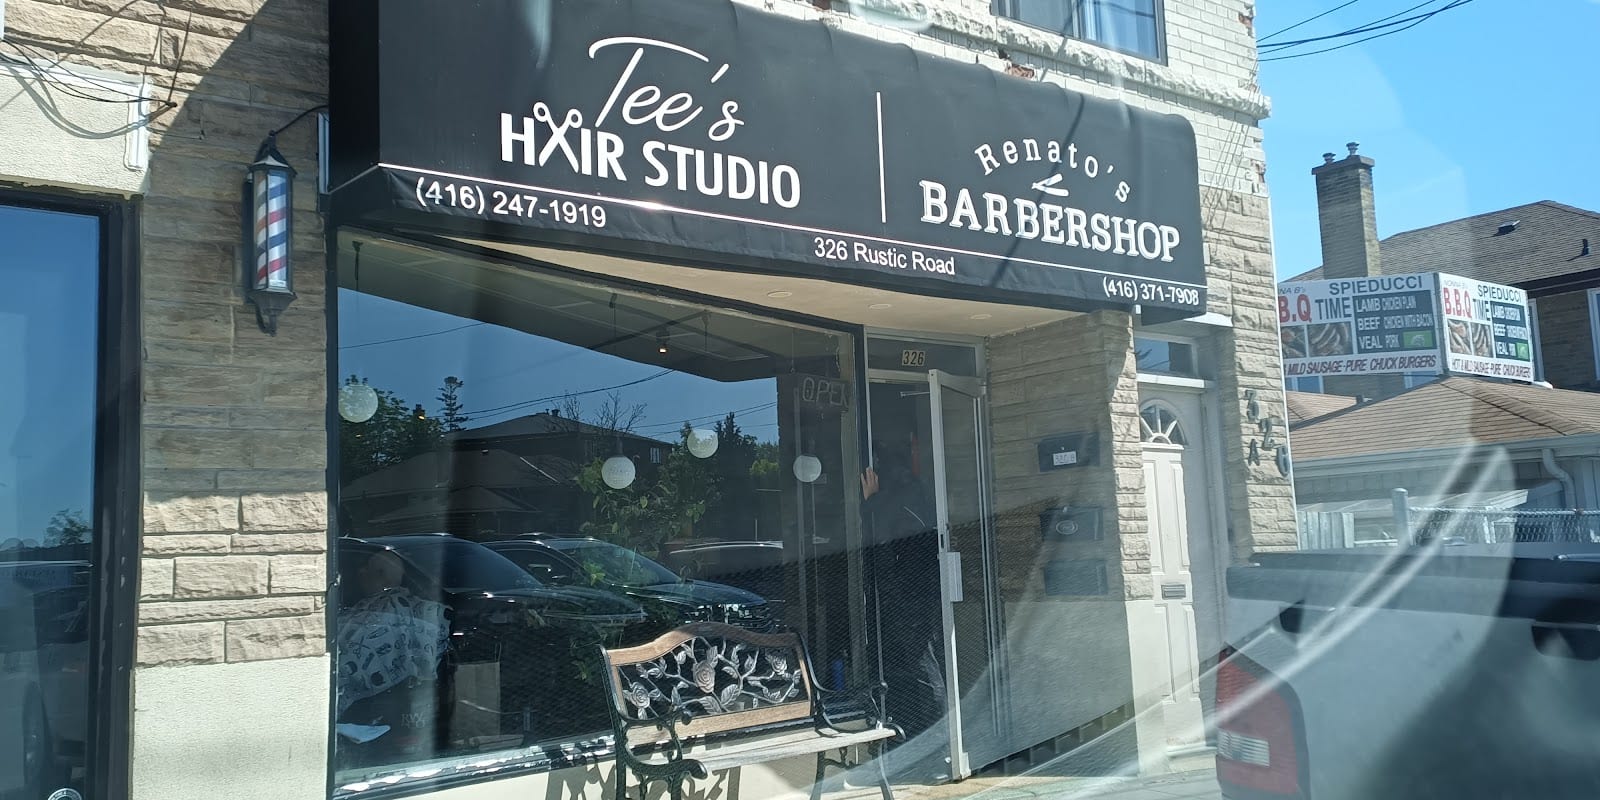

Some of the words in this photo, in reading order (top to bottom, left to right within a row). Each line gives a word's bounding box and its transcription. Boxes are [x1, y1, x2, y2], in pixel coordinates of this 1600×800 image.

[588, 36, 745, 142] Tee's
[643, 139, 802, 210] STUDIO
[974, 136, 1131, 204] Renato's
[415, 176, 486, 215] (416)
[493, 189, 607, 229] 247-1919
[919, 178, 1181, 264] BARBERSHOP
[813, 235, 849, 262] 326
[852, 240, 908, 269] Rustic
[912, 249, 956, 276] Road
[1102, 275, 1139, 301] (416)
[1140, 281, 1200, 307] 371-7908
[1329, 275, 1422, 296] SPIEDUCCI
[1477, 284, 1521, 302] SPIEDUCCI
[1315, 296, 1352, 320] TIME
[1356, 297, 1381, 313] LAMB
[1472, 298, 1491, 321] TIME
[1357, 317, 1380, 331] BEEF
[1359, 335, 1383, 349] VEAL
[903, 350, 925, 366] 326
[1369, 356, 1397, 371] CHUCK
[1398, 354, 1437, 370] BURGERS
[1247, 438, 1260, 466] A
